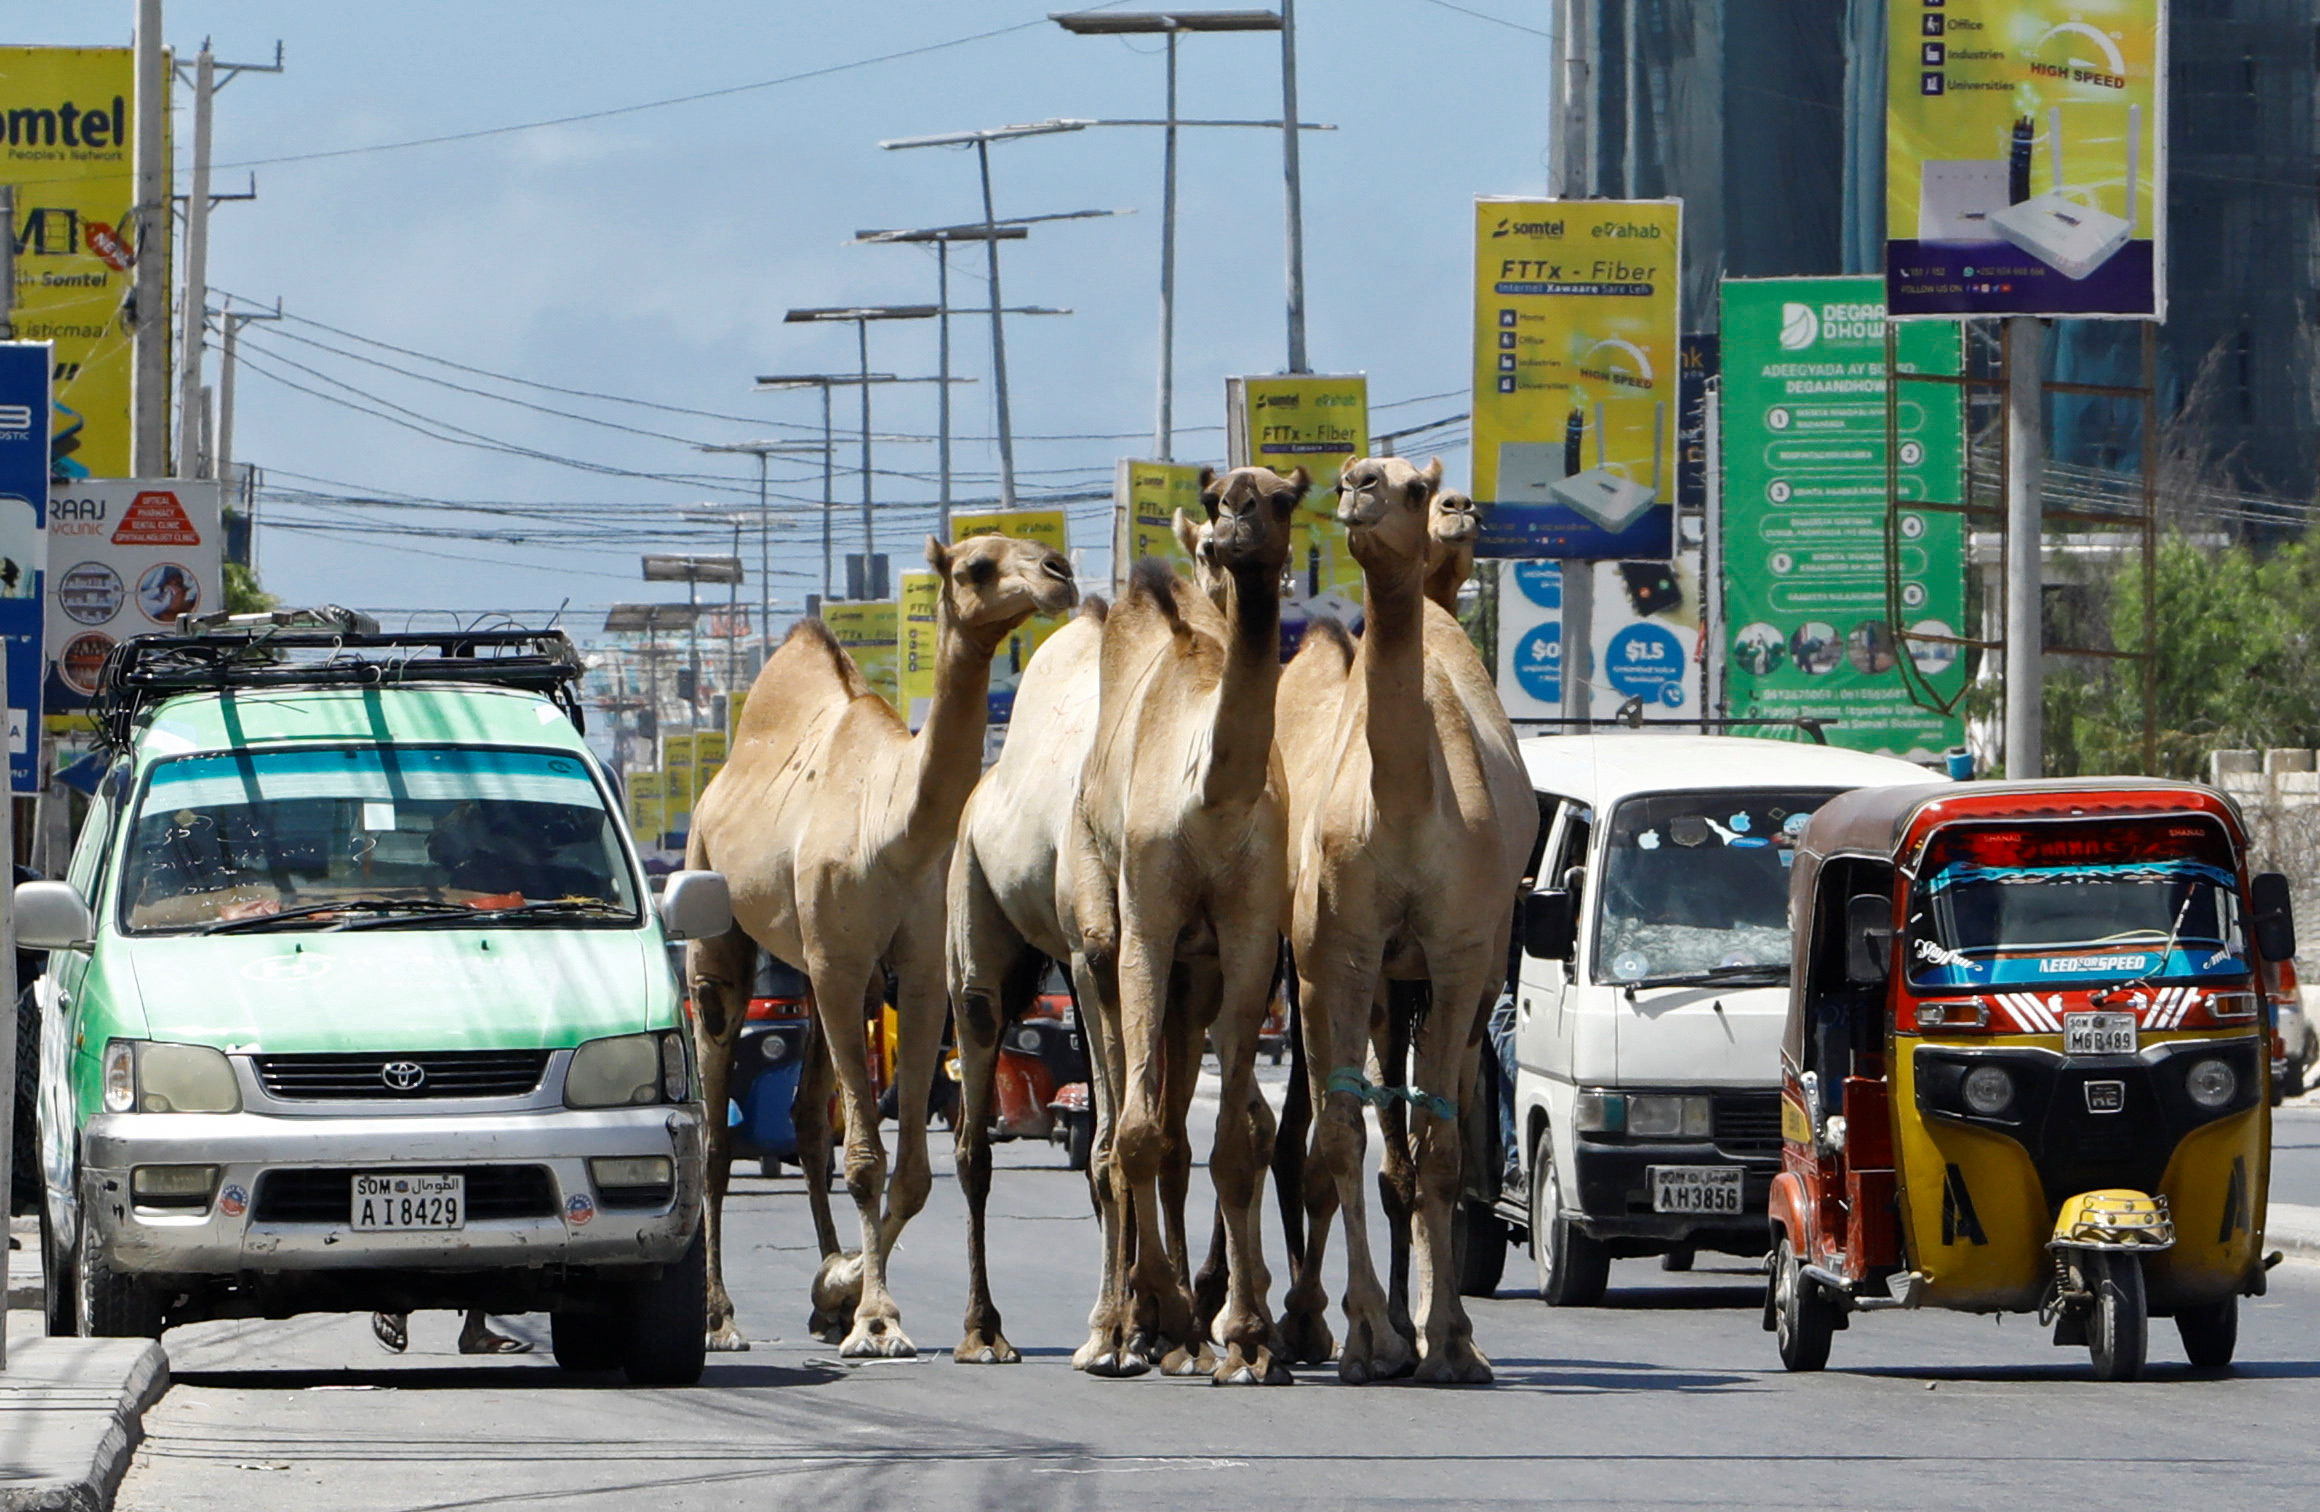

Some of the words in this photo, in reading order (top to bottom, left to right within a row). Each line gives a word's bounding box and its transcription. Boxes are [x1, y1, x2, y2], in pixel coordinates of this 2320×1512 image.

[1947, 19, 1984, 31] Office
[2030, 62, 2069, 79] HIGH
[2074, 70, 2126, 90] SPEED
[1947, 80, 2015, 92] Universities
[0, 95, 124, 147] mtel
[1513, 220, 1564, 235] somtel
[1502, 260, 1562, 279] FTTx
[1592, 261, 1657, 280] Fiber
[42, 271, 108, 287] Somtel
[1823, 304, 1885, 321] DEGAA
[1823, 322, 1899, 339] DHOW
[1613, 374, 1653, 389] SPEED
[2039, 959, 2077, 973] NEED
[2098, 955, 2146, 971] SPEED
[358, 1180, 391, 1194] SOM
[1661, 1186, 1737, 1209] AH3856
